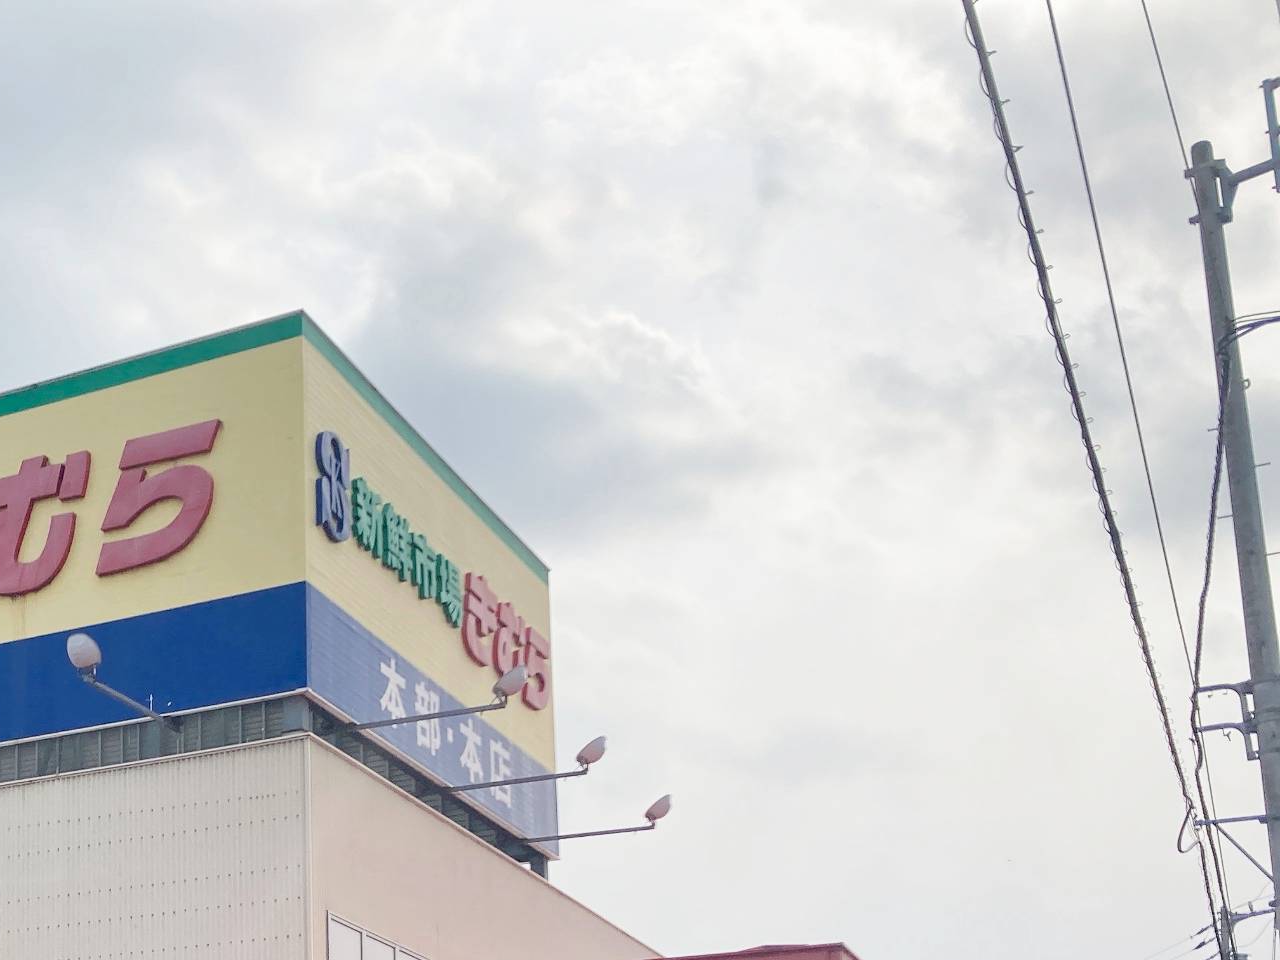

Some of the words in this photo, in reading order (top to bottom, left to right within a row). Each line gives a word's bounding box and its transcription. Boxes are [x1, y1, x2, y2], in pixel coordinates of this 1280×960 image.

[350, 475, 464, 629] 新鮮市場
[460, 571, 552, 712] きむら
